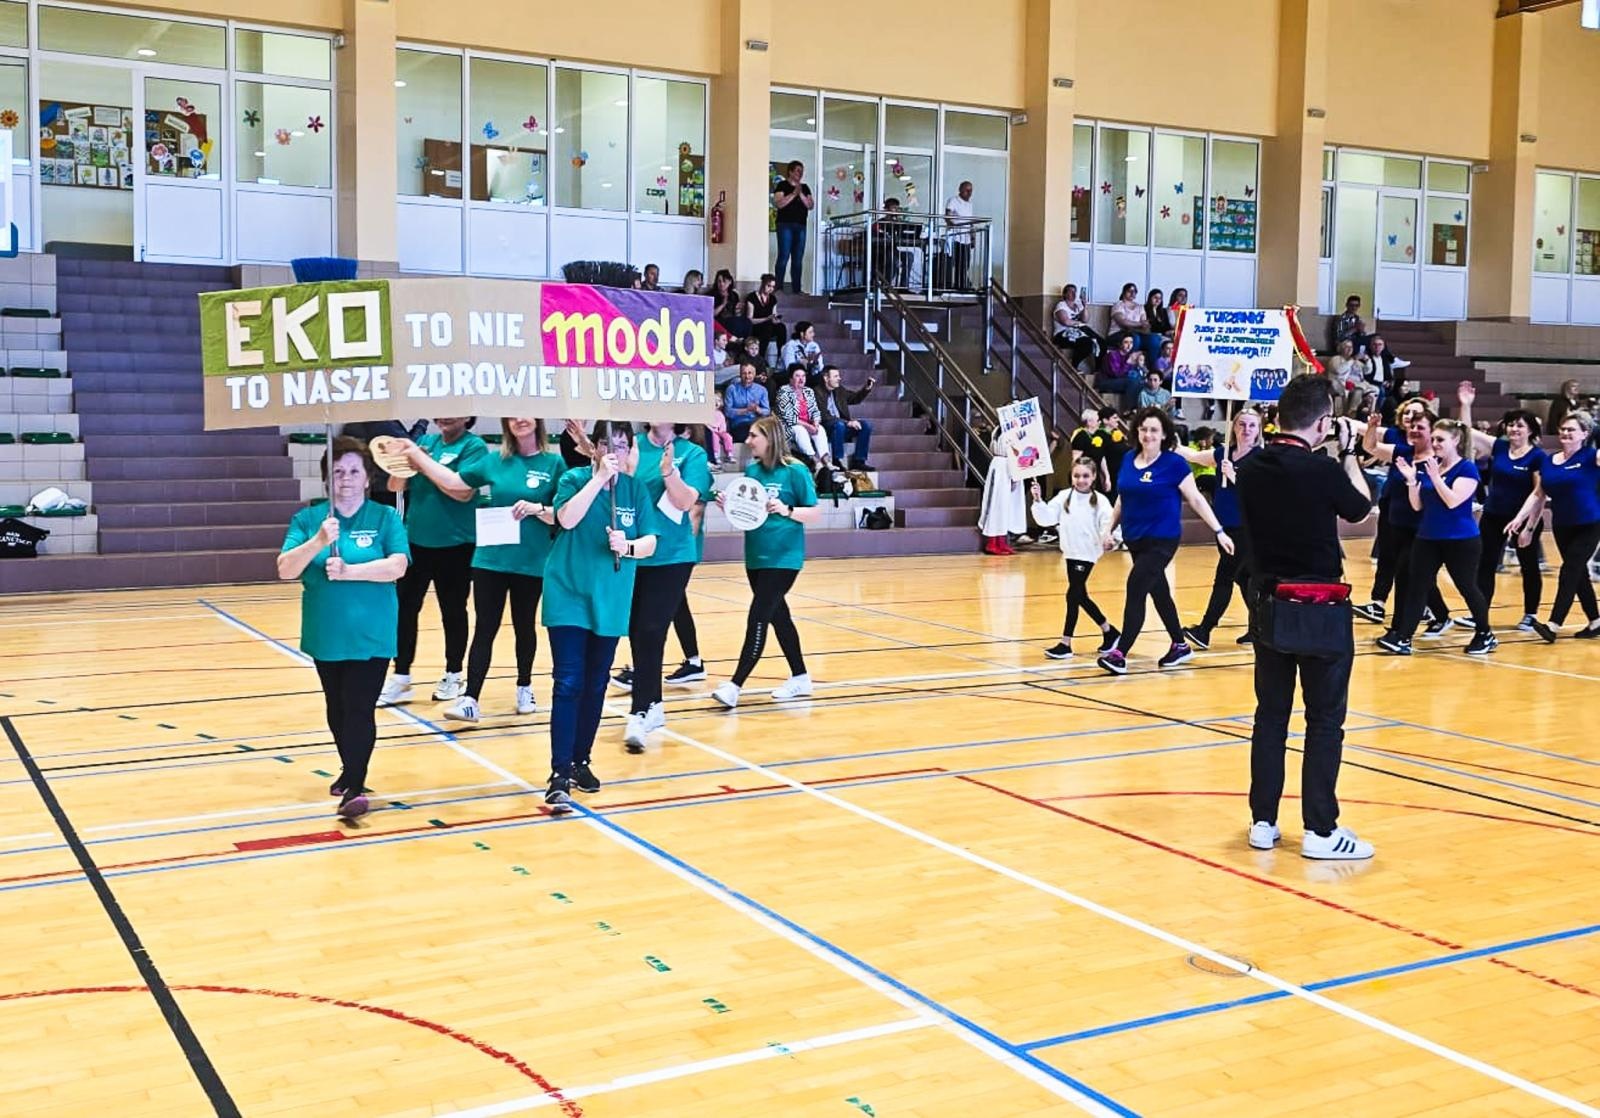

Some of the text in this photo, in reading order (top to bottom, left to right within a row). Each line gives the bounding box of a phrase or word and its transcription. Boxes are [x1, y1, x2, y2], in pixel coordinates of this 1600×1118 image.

[225, 291, 710, 367] EKO TO NIE moda
[225, 362, 706, 410] TO NASZE ZDROWIE I URODA!
